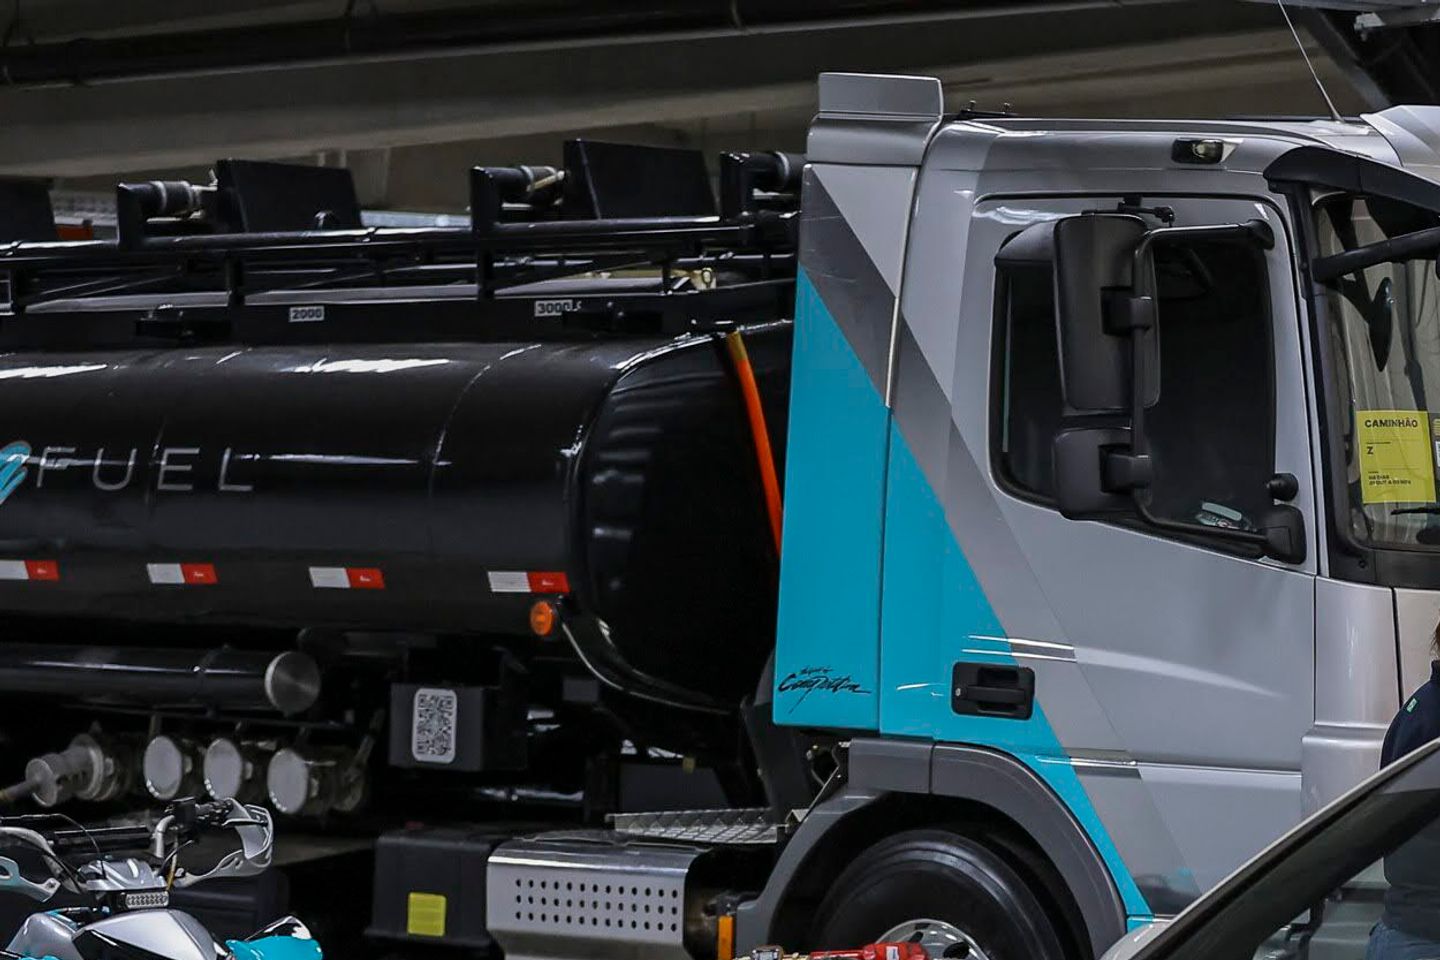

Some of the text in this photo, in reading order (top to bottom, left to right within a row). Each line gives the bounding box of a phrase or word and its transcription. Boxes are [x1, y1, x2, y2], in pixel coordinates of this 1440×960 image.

[1364, 416, 1419, 428] CAMINHÃO
[1366, 446, 1374, 455] Z
[36, 446, 254, 491] FUEL
